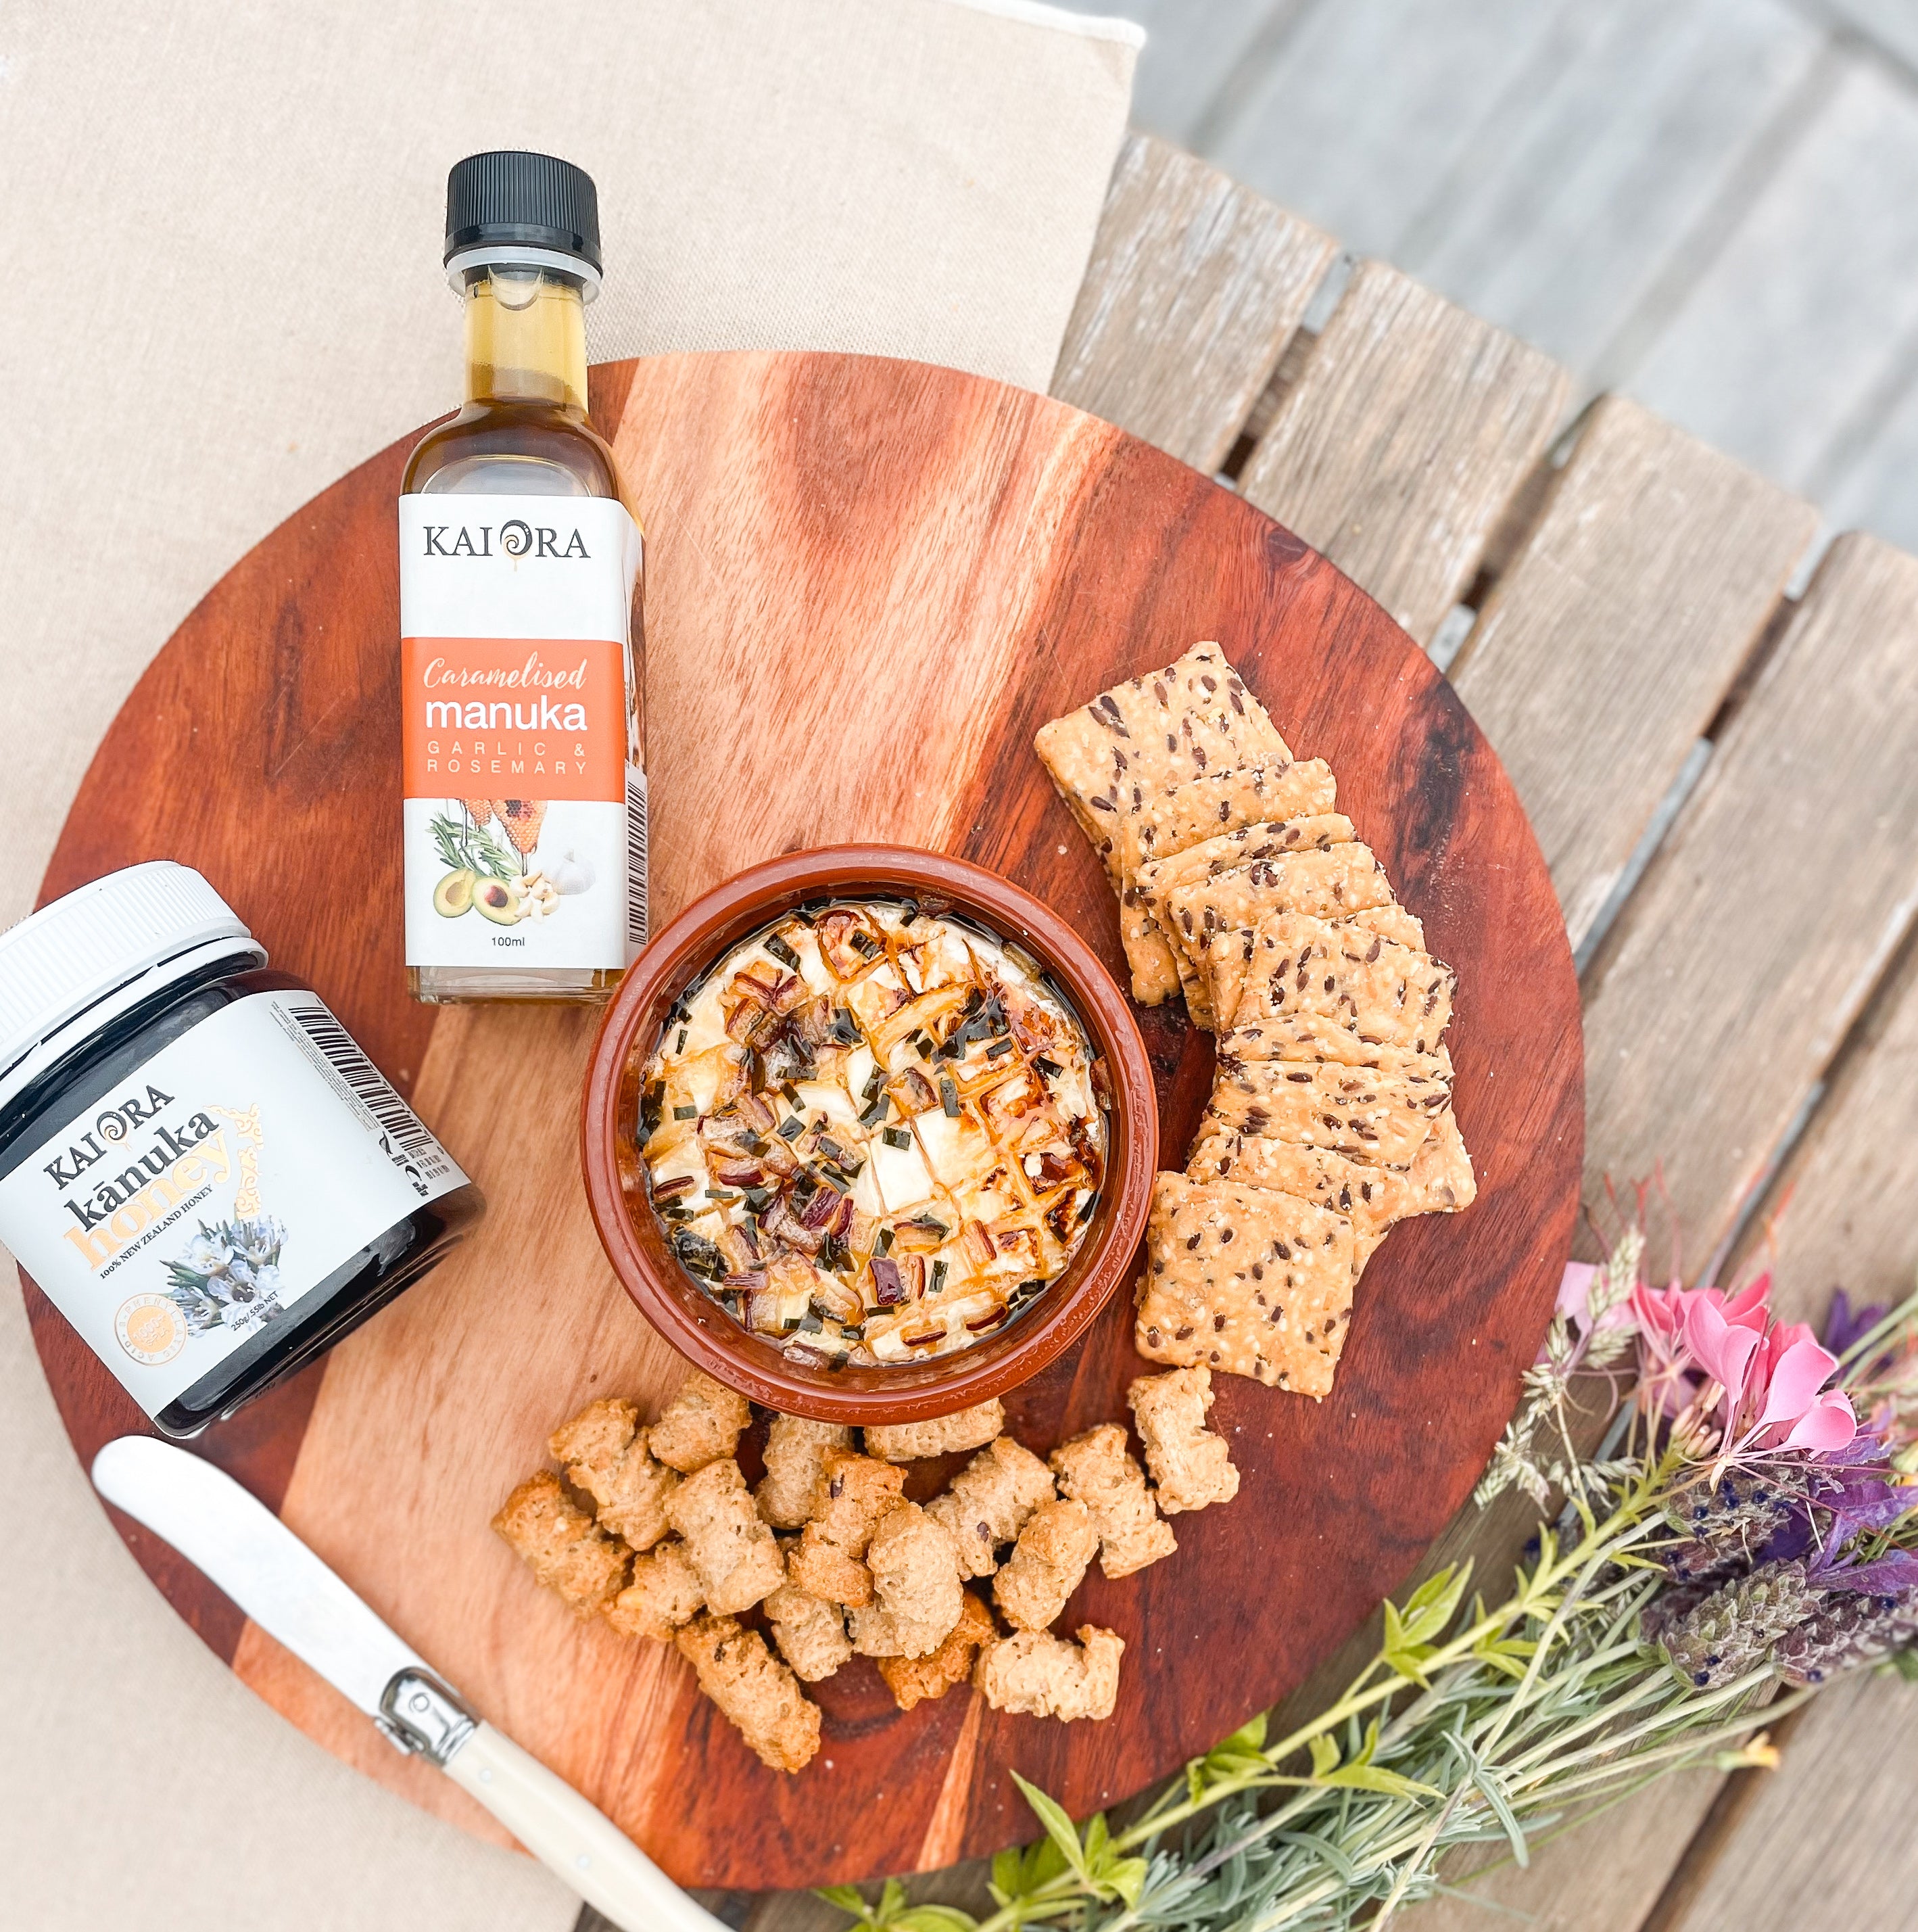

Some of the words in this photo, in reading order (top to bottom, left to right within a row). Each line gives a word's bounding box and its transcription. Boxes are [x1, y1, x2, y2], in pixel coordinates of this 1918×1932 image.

[423, 651, 588, 690] Caramelised
[426, 694, 588, 731] manuka
[427, 740, 546, 756] GARLIC
[574, 743, 585, 757] &
[427, 759, 587, 775] ROSEMARY
[491, 937, 526, 947] 100ml
[63, 1112, 220, 1233] kānuka
[63, 1128, 231, 1271] honey
[99, 1258, 122, 1279] 100%
[118, 1241, 141, 1263] NEW
[140, 1210, 182, 1246] ZEALAND
[180, 1183, 214, 1214] HONEY
[263, 1290, 279, 1305] NET
